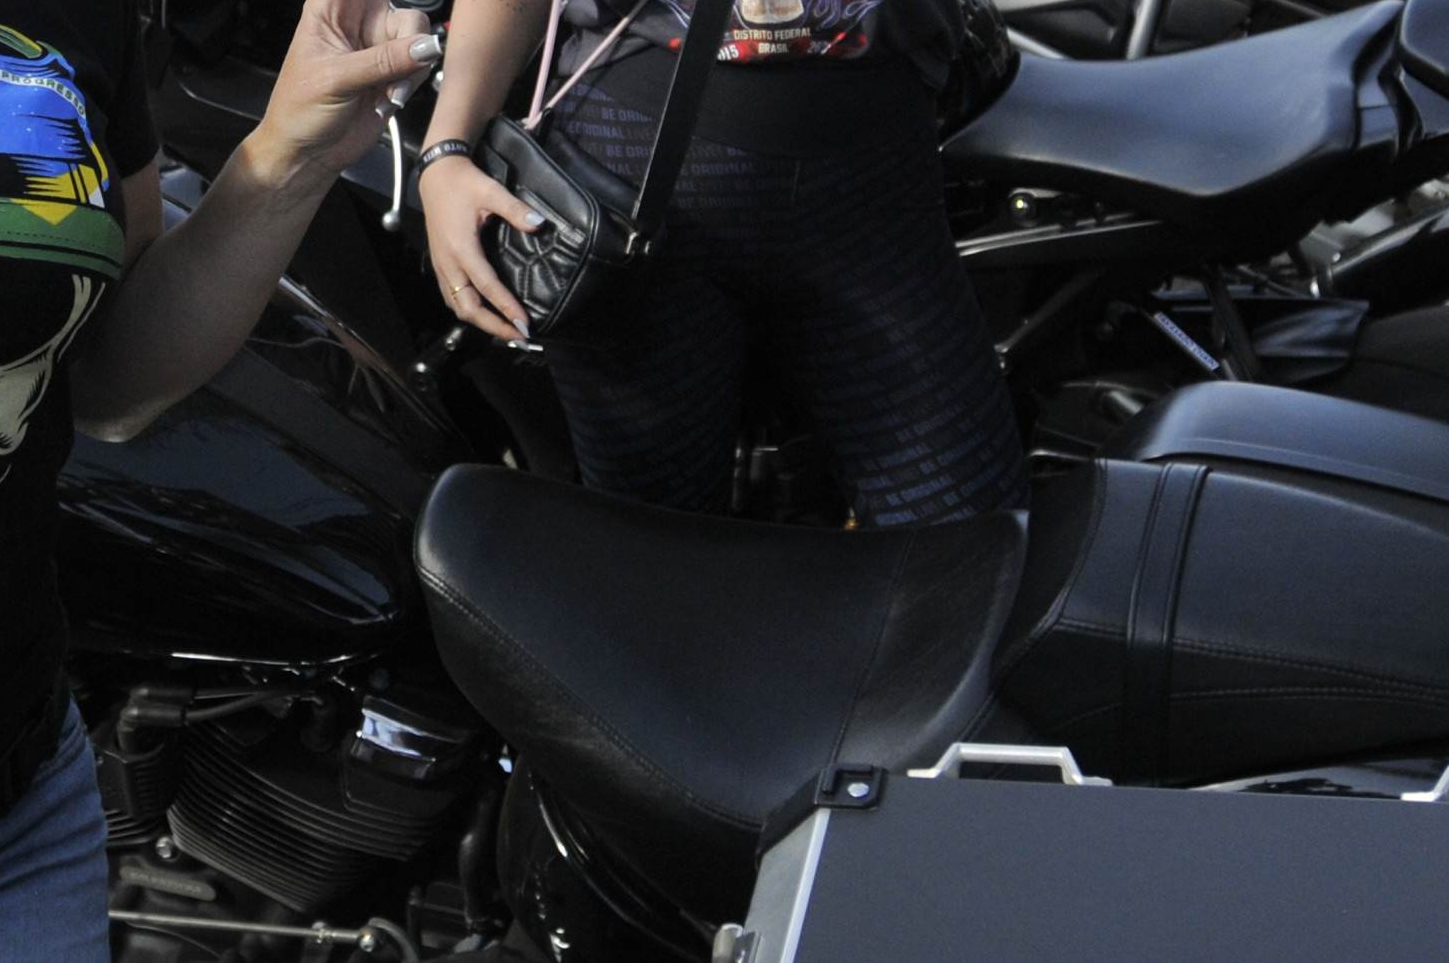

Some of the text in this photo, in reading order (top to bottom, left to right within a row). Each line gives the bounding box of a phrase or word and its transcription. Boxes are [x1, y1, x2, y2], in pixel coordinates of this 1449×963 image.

[734, 27, 812, 41] DISTRITO FEDERAL
[758, 42, 789, 54] BRASIL
[1, 72, 86, 116] PROGRESSO
